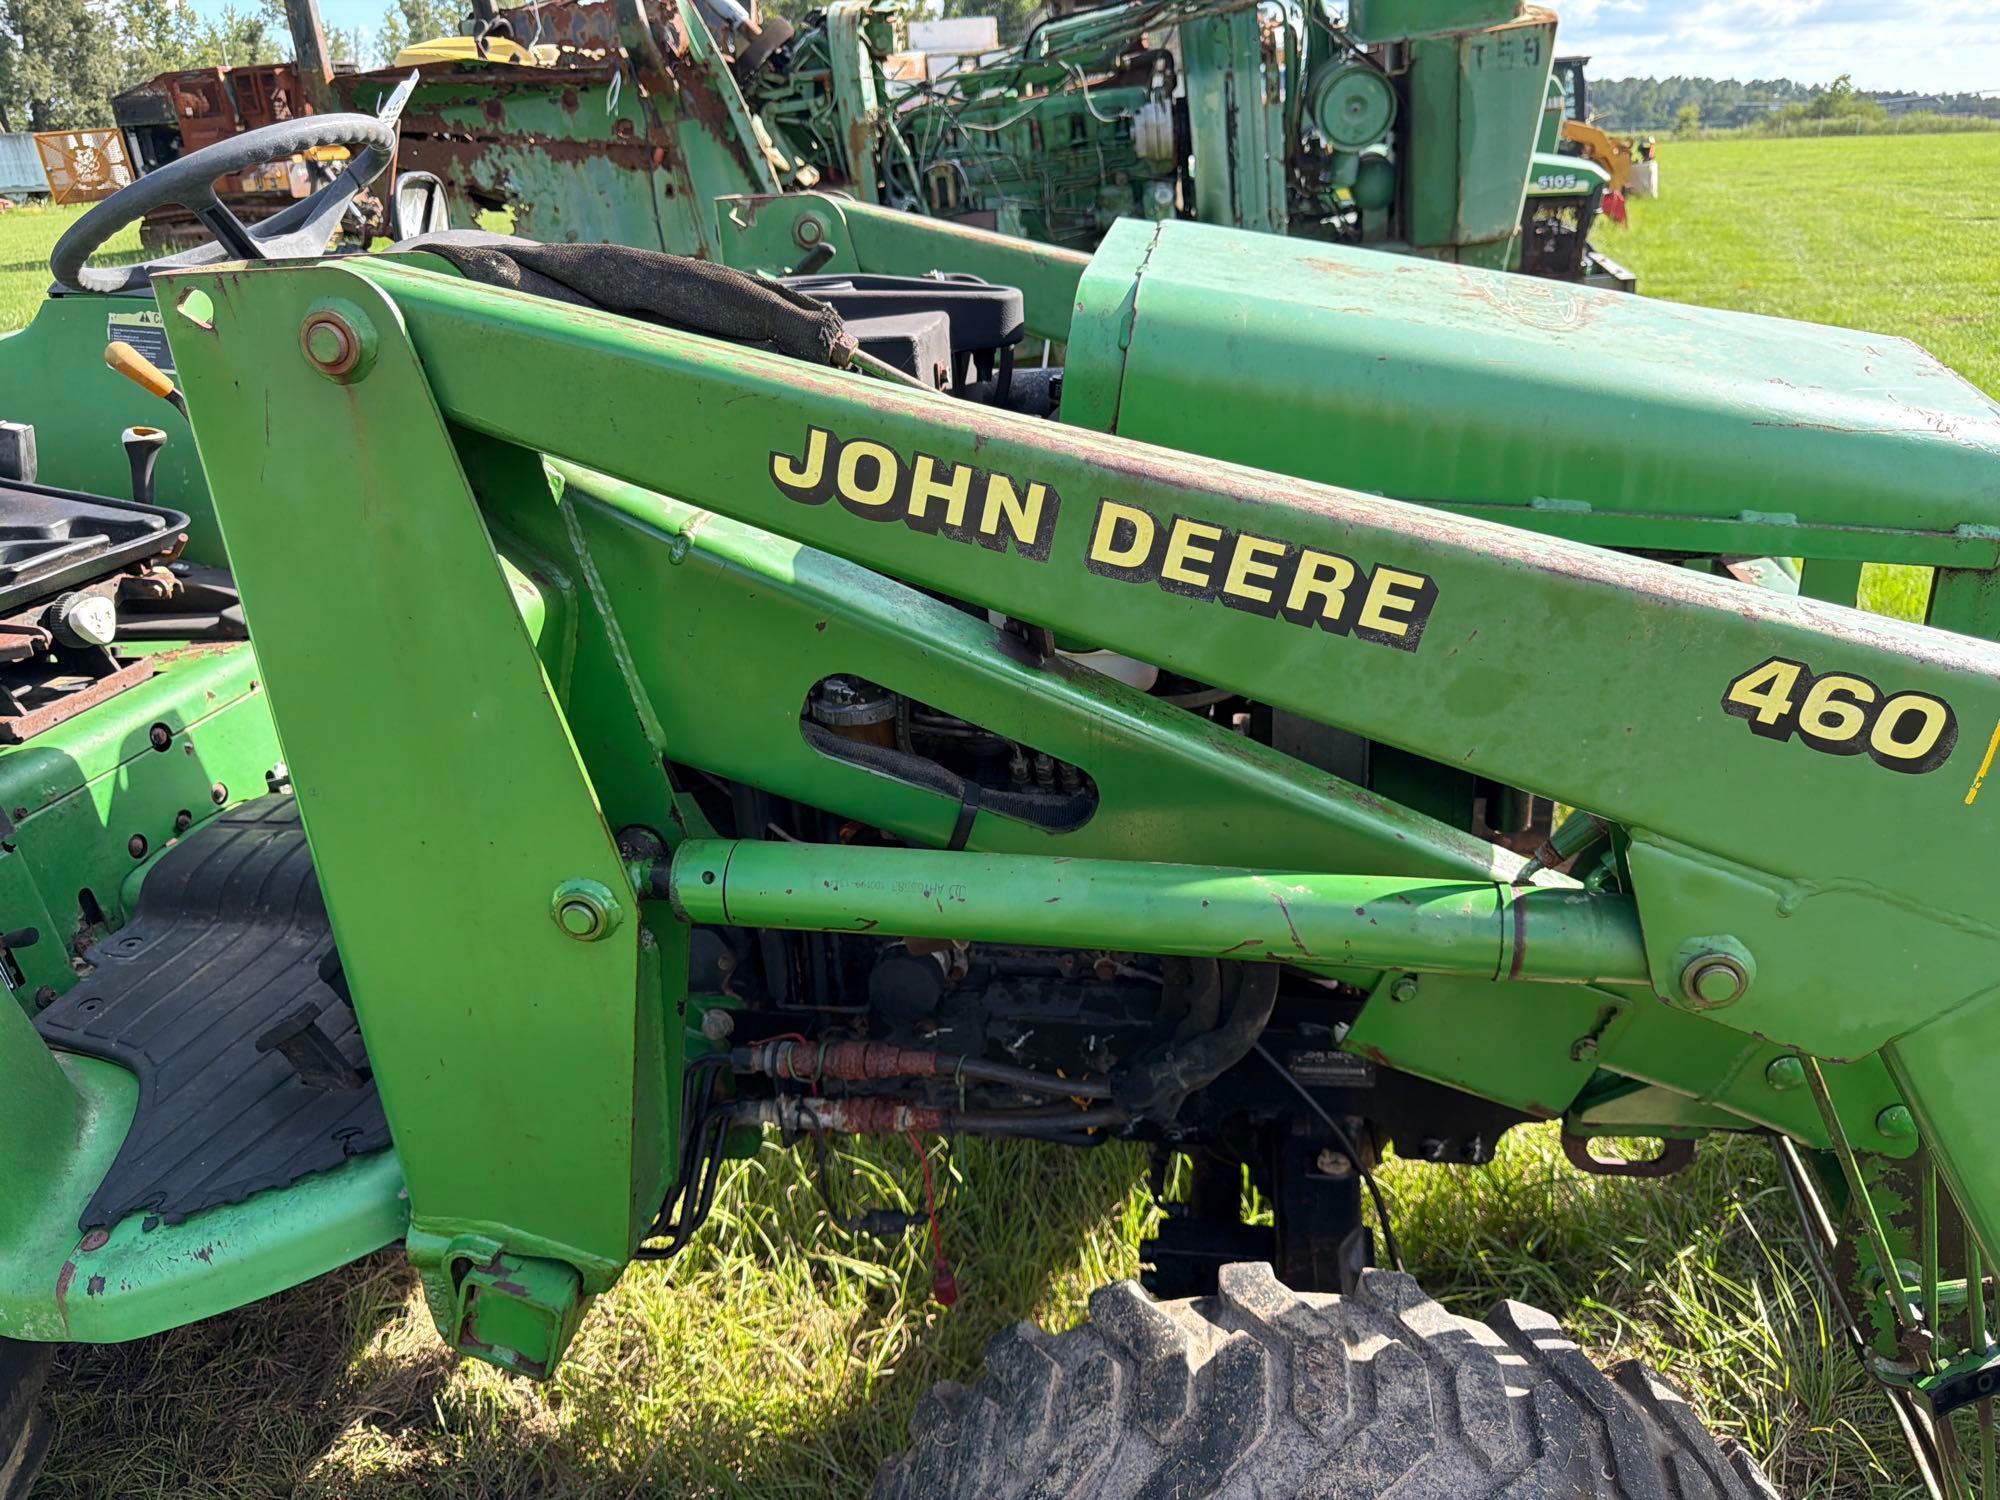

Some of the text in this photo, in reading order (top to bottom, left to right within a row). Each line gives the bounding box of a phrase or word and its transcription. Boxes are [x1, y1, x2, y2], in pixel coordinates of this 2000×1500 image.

[772, 427, 1426, 637] JOHN DEERE
[1727, 660, 1948, 760] 460
